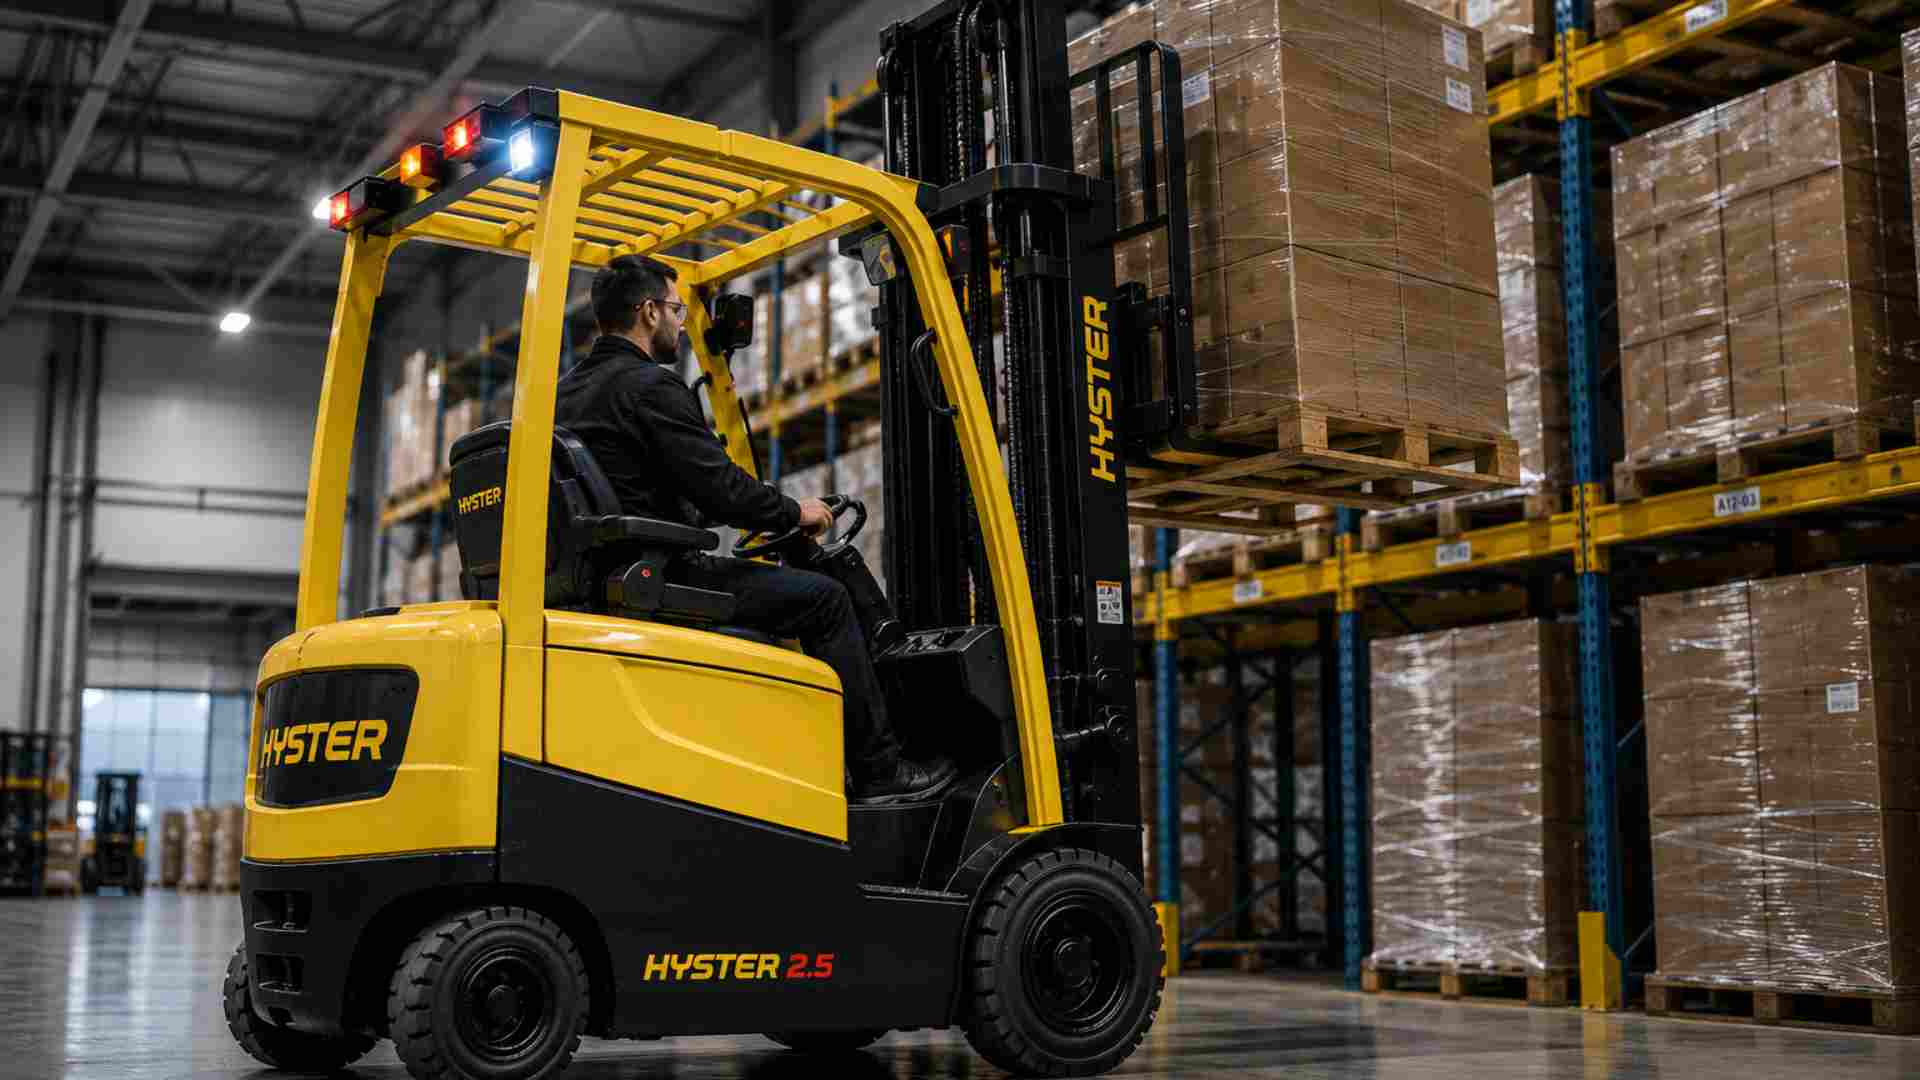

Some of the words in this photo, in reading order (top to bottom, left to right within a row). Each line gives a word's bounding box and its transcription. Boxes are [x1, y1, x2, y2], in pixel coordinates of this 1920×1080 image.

[1083, 295, 1116, 482] HYSTER
[457, 487, 502, 514] HYSTER
[260, 719, 388, 768] HYSTER
[643, 953, 781, 981] HYSTER
[786, 953, 834, 978] 2.5
